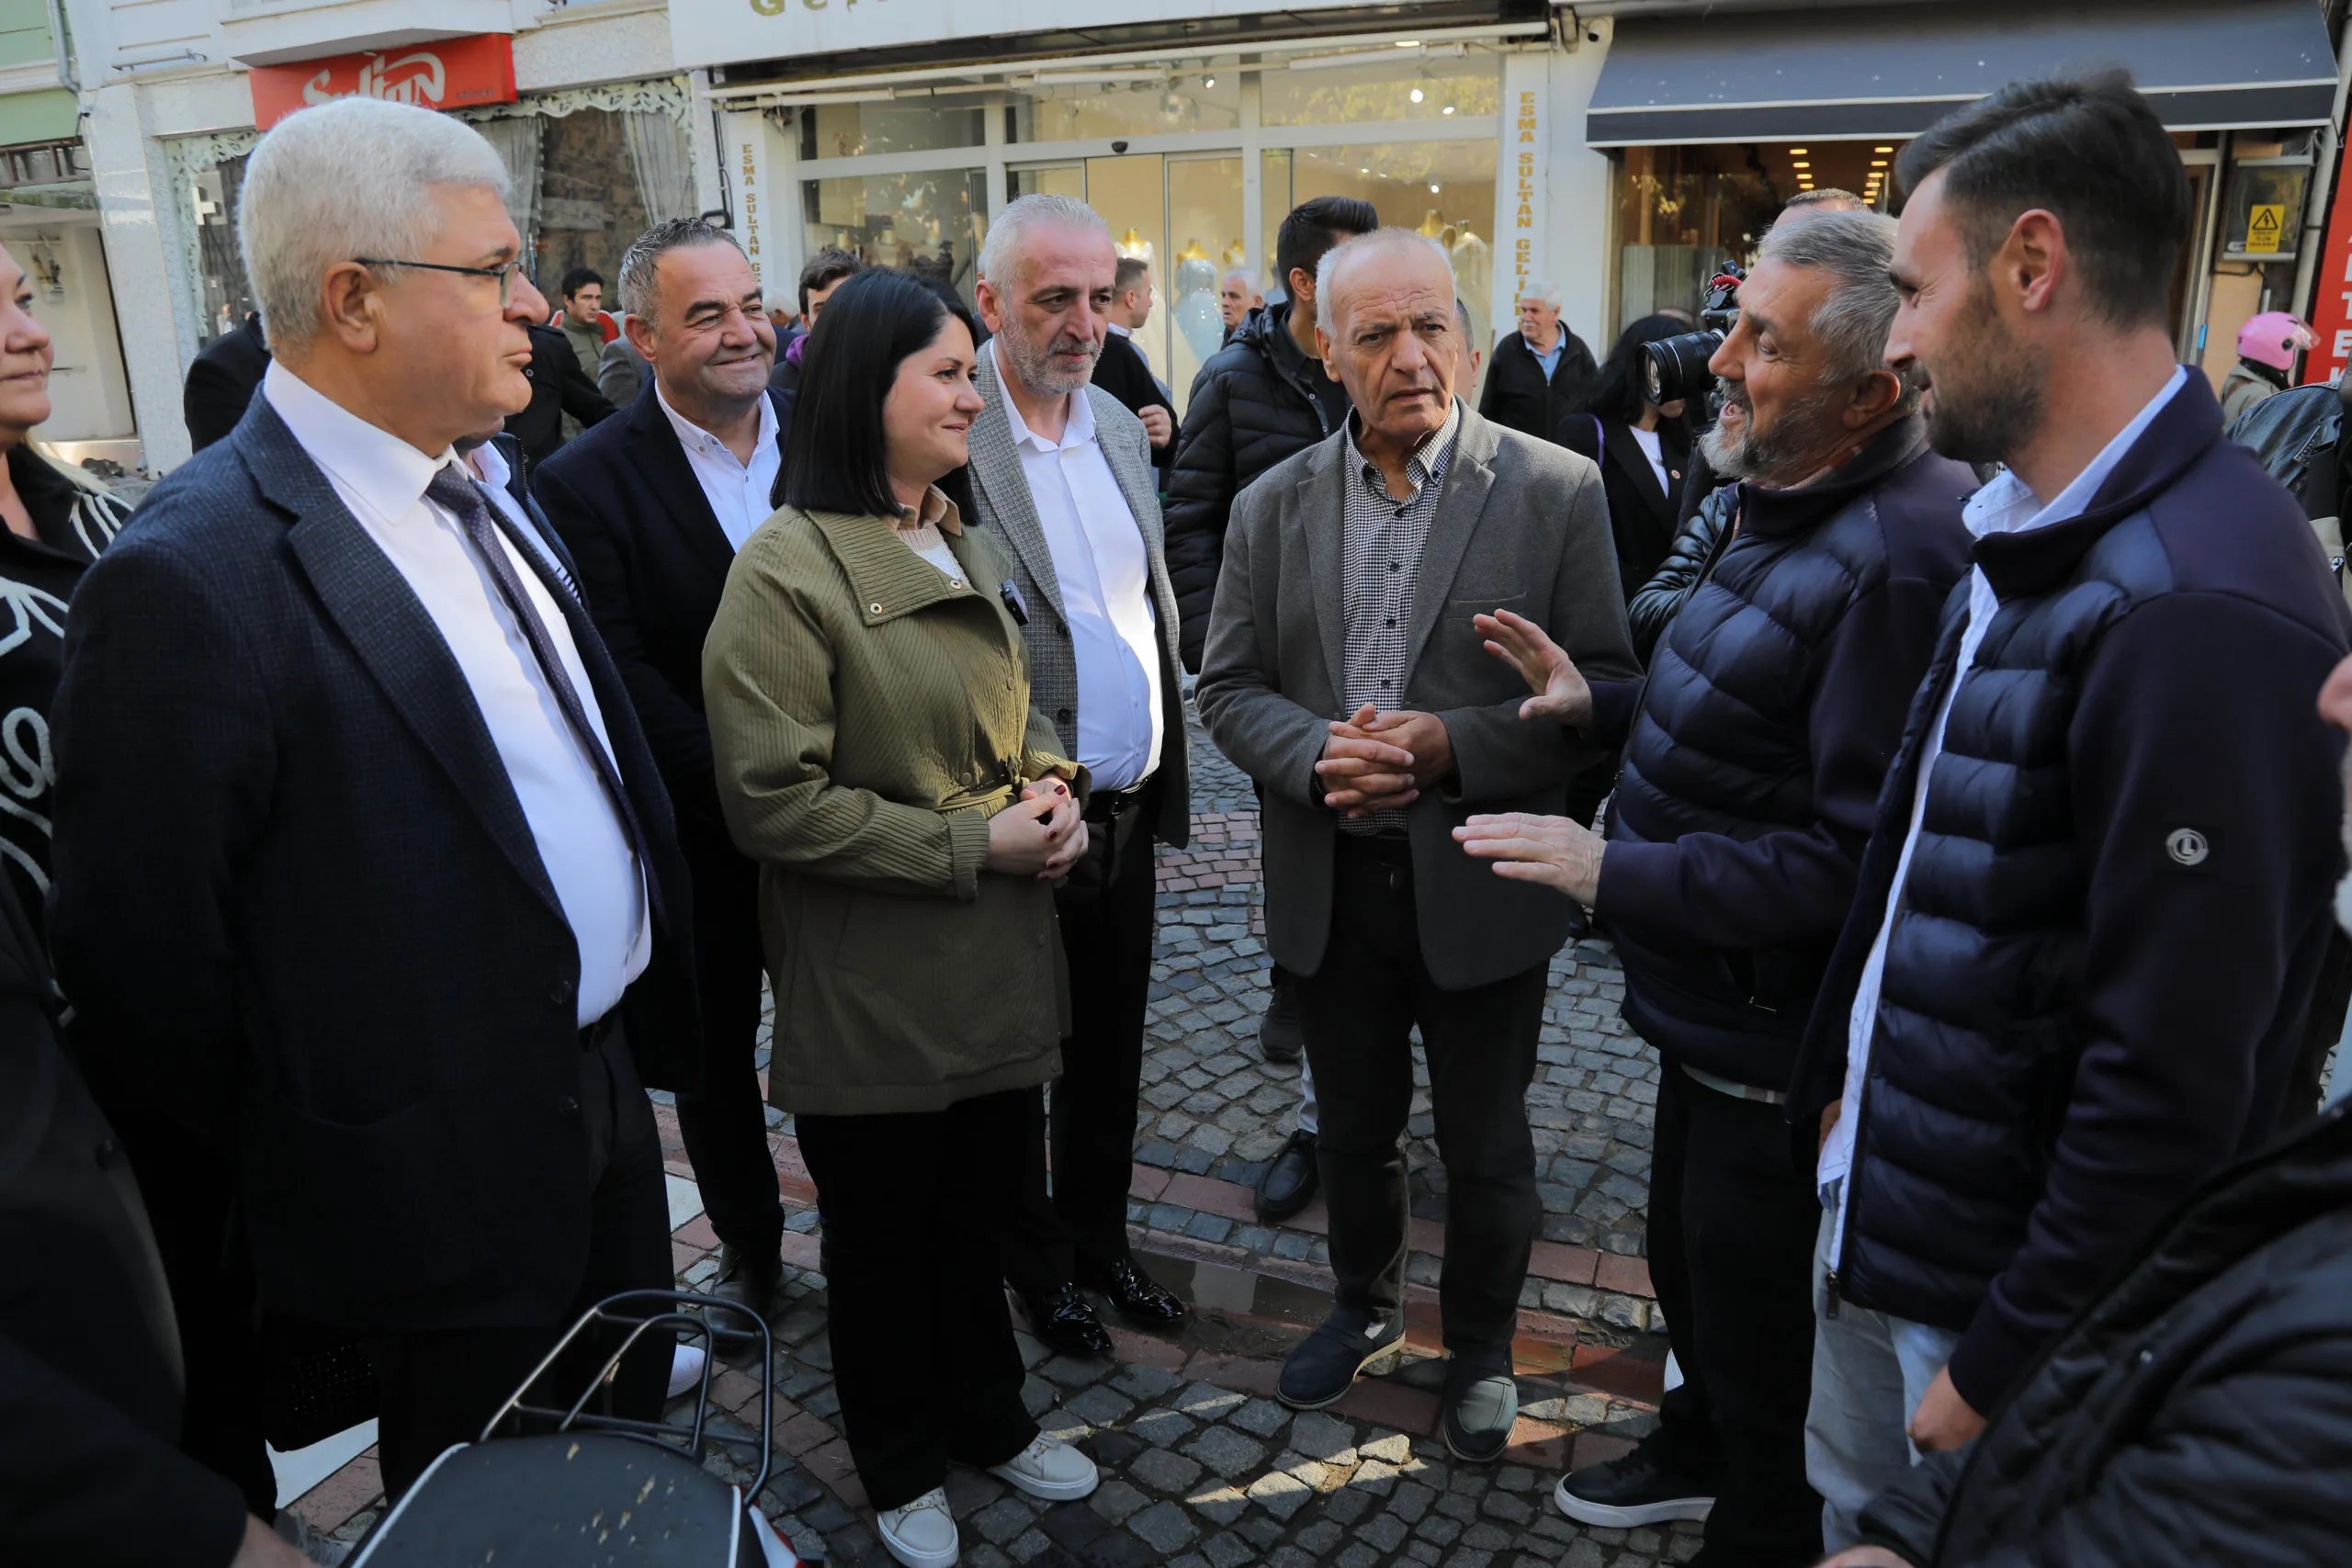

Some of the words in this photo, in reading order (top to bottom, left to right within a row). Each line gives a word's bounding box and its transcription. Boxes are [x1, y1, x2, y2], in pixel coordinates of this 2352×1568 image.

[1517, 91, 1536, 143] ESMA
[741, 143, 756, 186] ESMA
[1517, 152, 1534, 229] SULTAN
[745, 193, 760, 255] SULTAN
